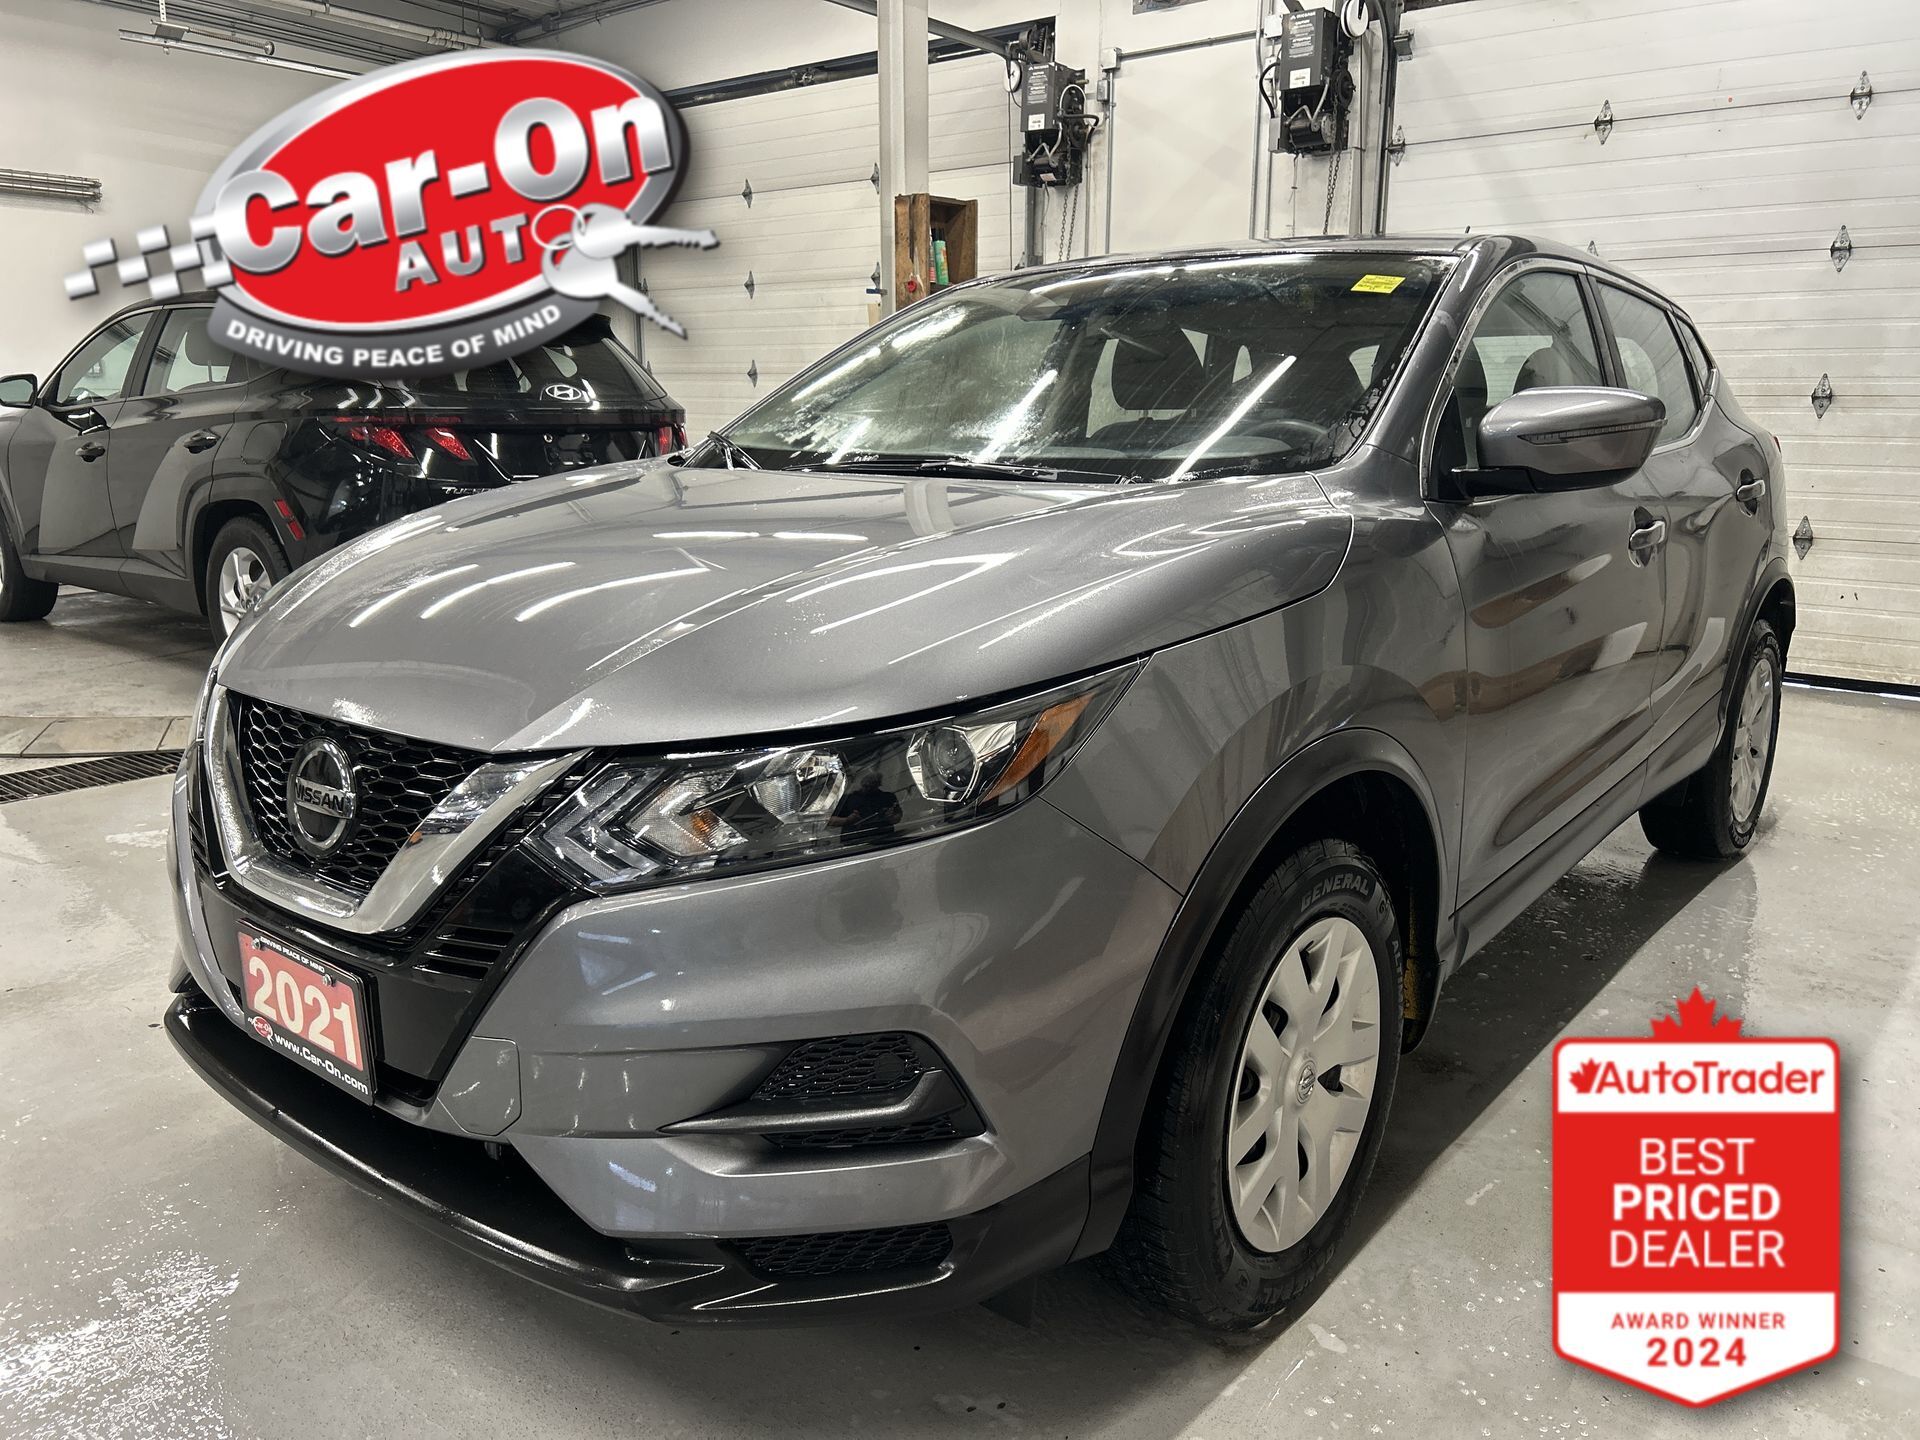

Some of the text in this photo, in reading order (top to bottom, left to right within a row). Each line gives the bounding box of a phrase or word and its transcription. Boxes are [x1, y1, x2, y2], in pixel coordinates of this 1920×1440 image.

[295, 782, 344, 812] NISSAN
[1300, 873, 1369, 912] GENERAL
[260, 936, 325, 973] DRIVING PEACE OF MIND
[249, 956, 358, 1066] 2021
[274, 1032, 369, 1096] www.Car-On.com
